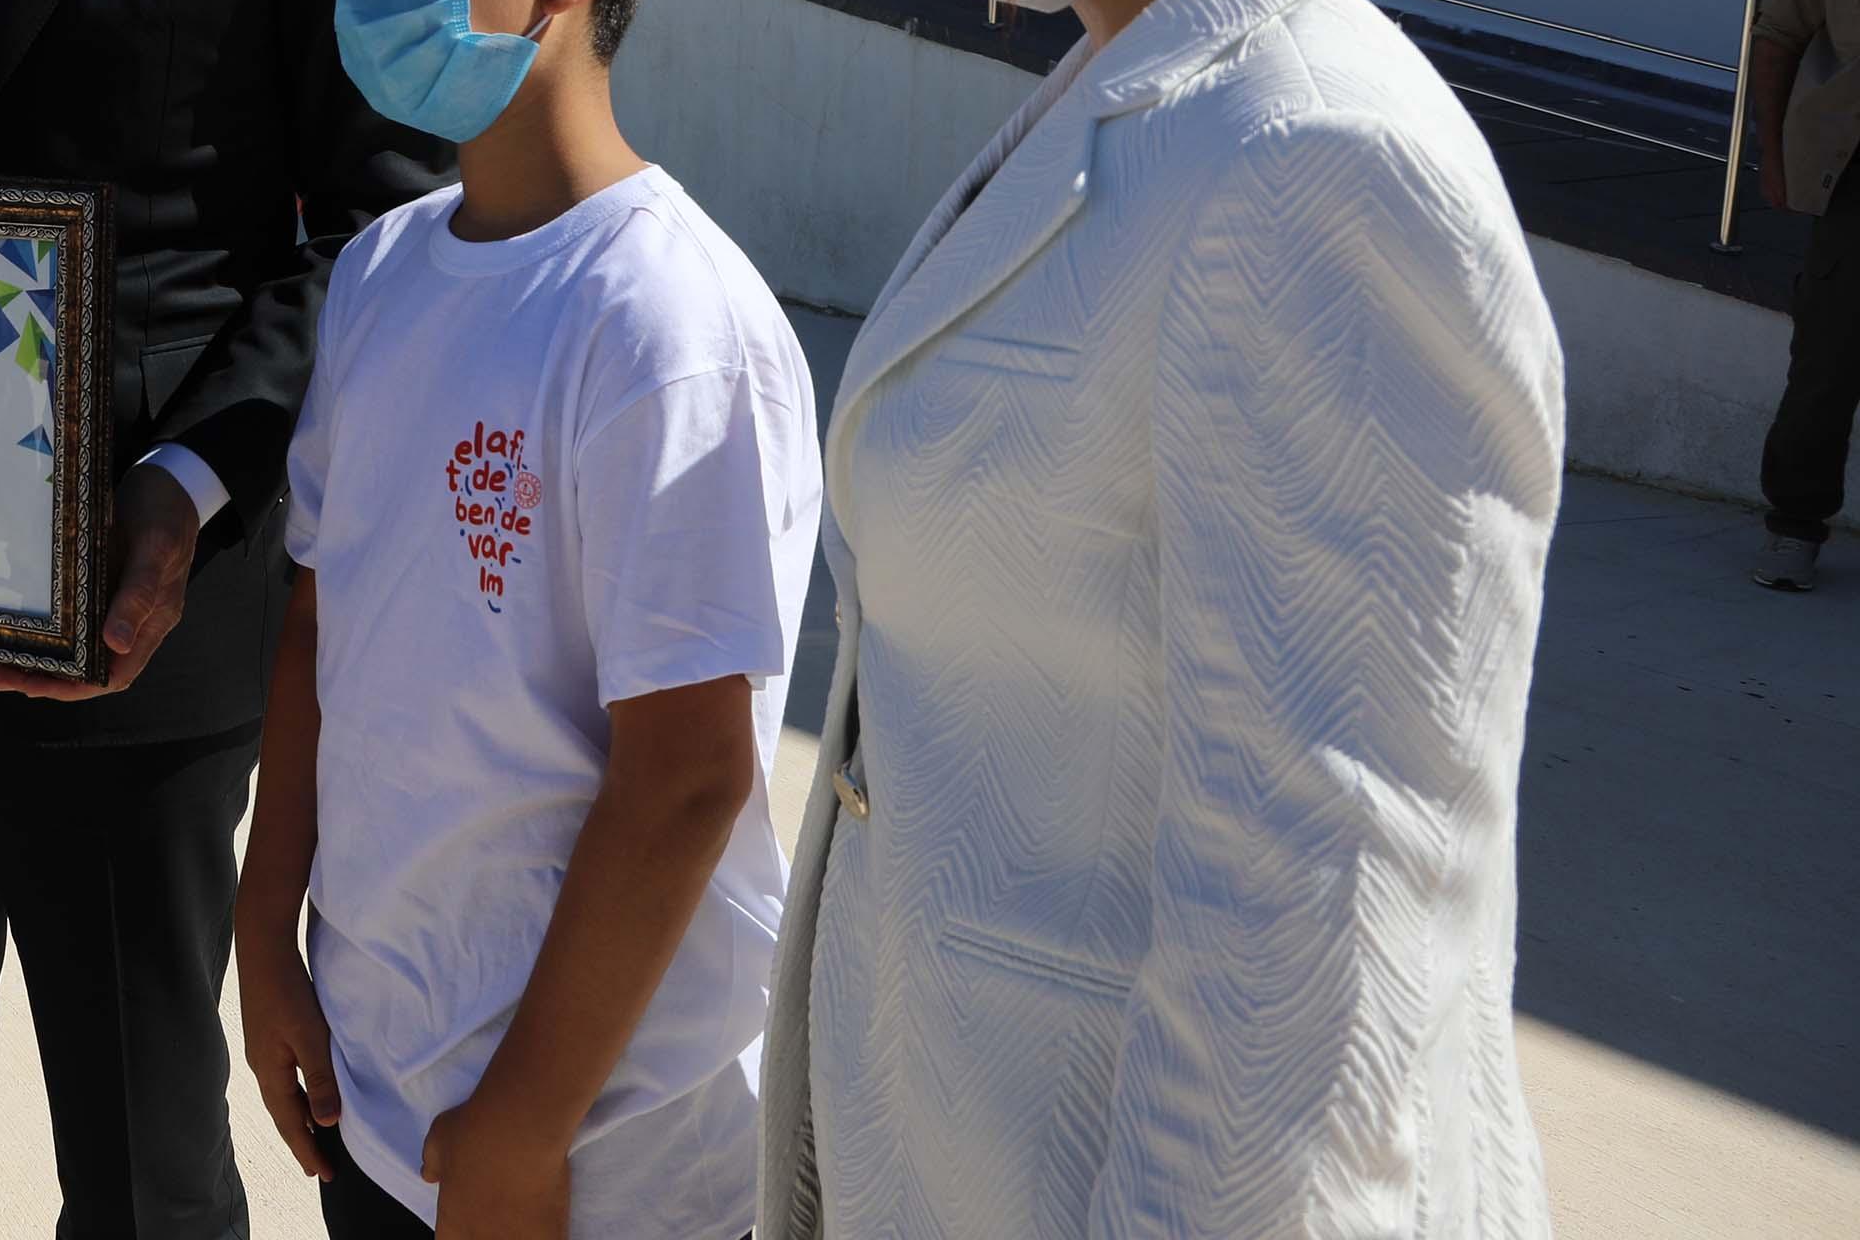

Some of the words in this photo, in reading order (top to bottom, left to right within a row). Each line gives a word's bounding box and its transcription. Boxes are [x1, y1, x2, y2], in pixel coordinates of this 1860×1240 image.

[445, 420, 525, 492] telafi
[472, 460, 507, 493] de
[455, 495, 495, 526] ben
[500, 505, 531, 536] de
[467, 534, 514, 568] var
